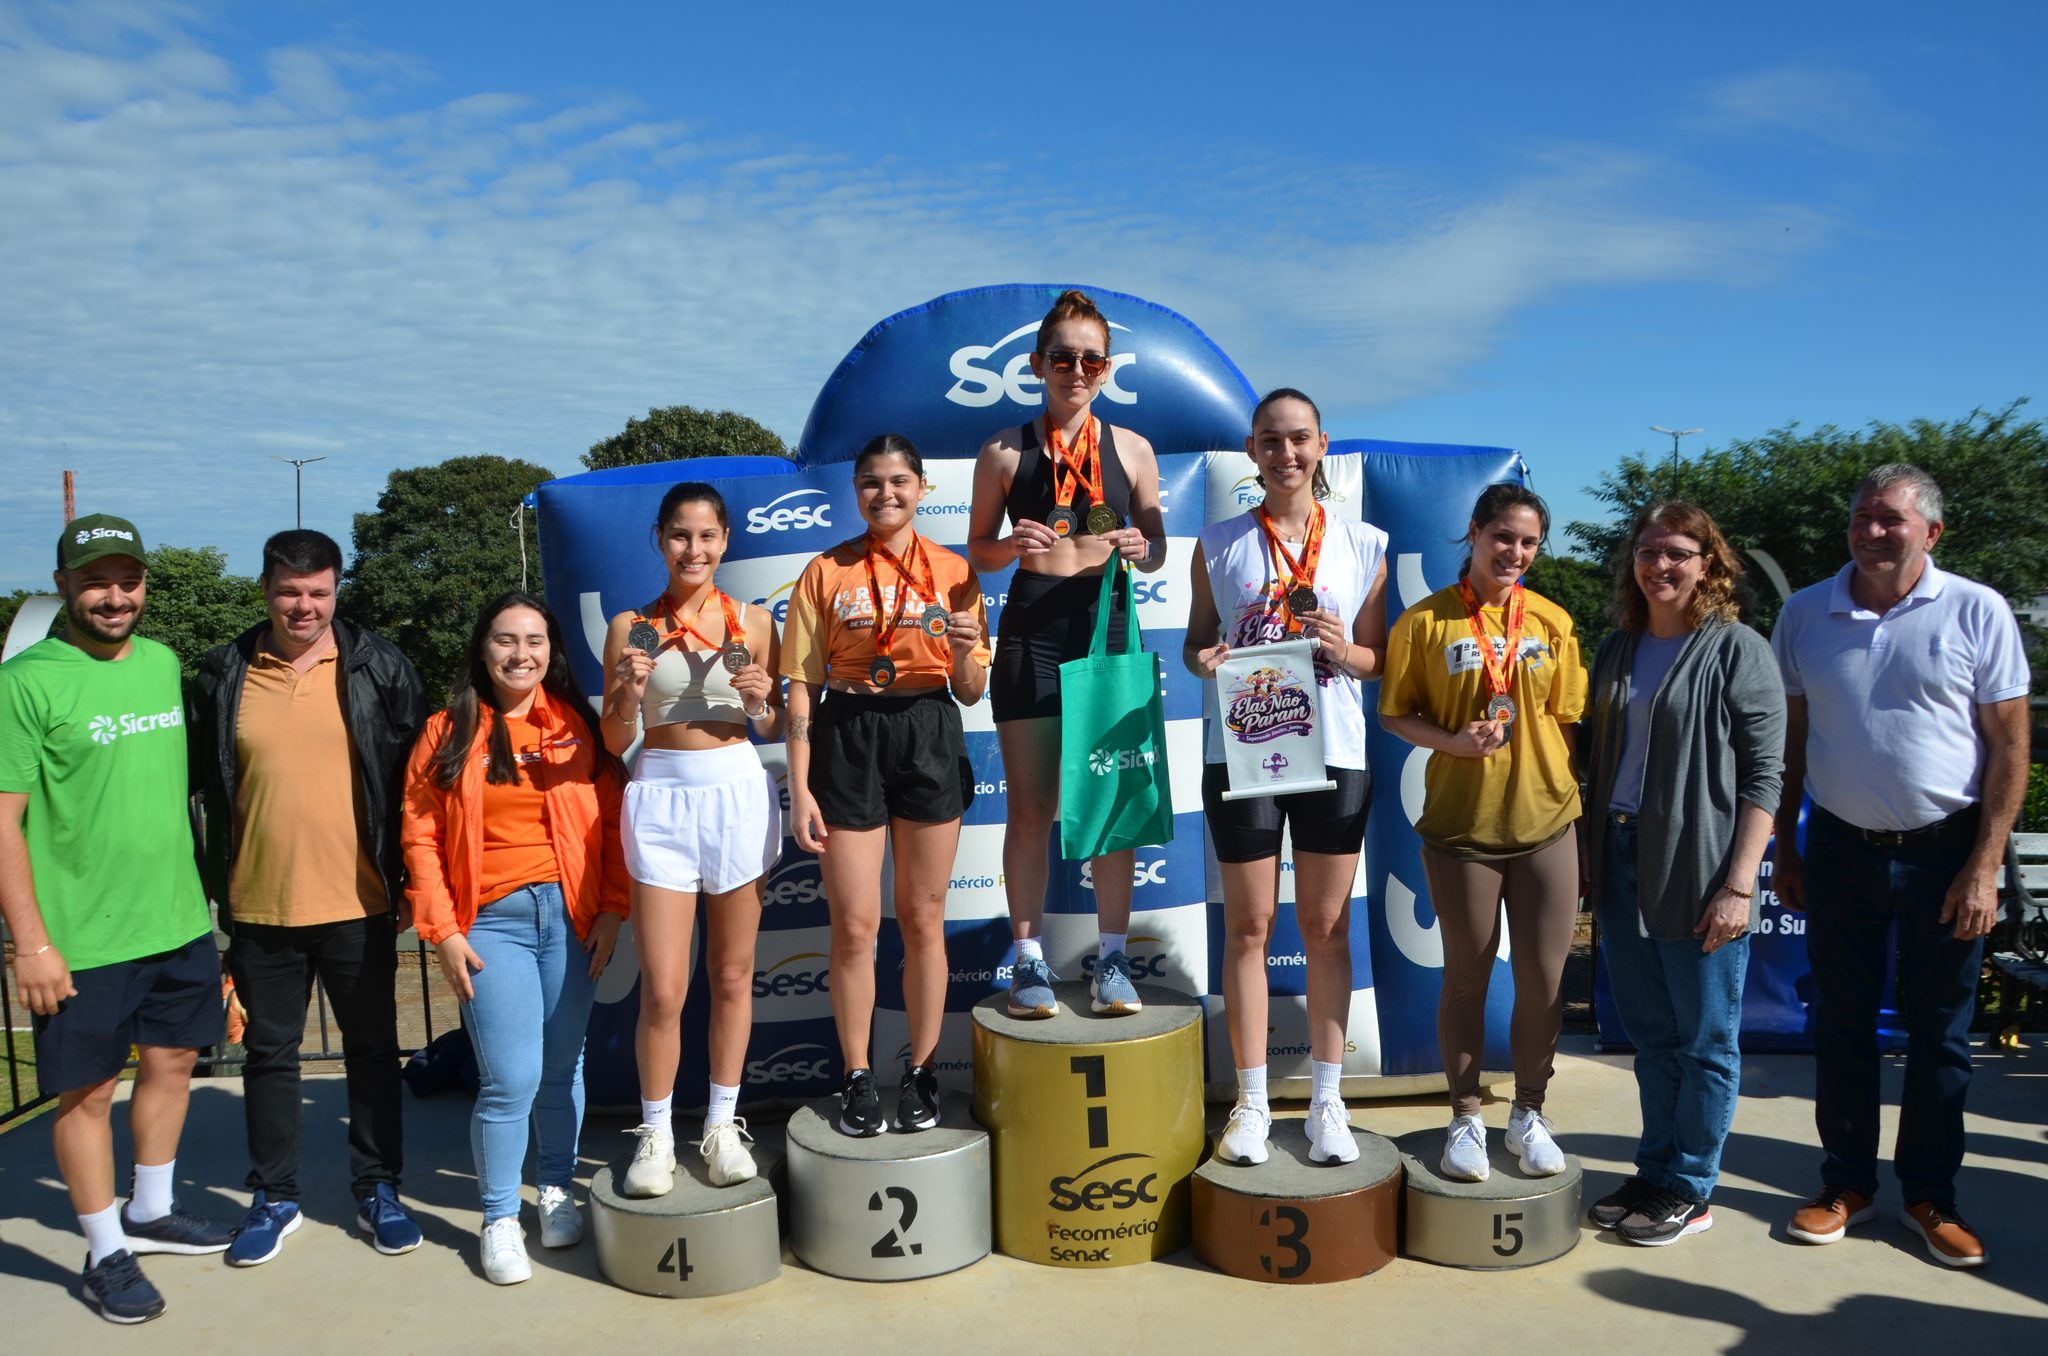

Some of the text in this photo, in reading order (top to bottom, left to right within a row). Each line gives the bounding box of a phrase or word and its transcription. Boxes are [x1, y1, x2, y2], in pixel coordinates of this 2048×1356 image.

[945, 345, 1138, 408] Sec
[91, 527, 133, 542] Sicredi
[119, 705, 183, 736] Sicredi
[1234, 692, 1303, 720] Elas Não
[1242, 705, 1308, 734] Param
[1048, 1172, 1158, 1212] Sesc
[868, 1186, 923, 1259] 2
[1048, 1219, 1159, 1242] Fecomércio
[1492, 1212, 1524, 1257] 5
[657, 1237, 694, 1282] 4
[1050, 1245, 1113, 1262] Senac
[1259, 1206, 1312, 1280] 3
